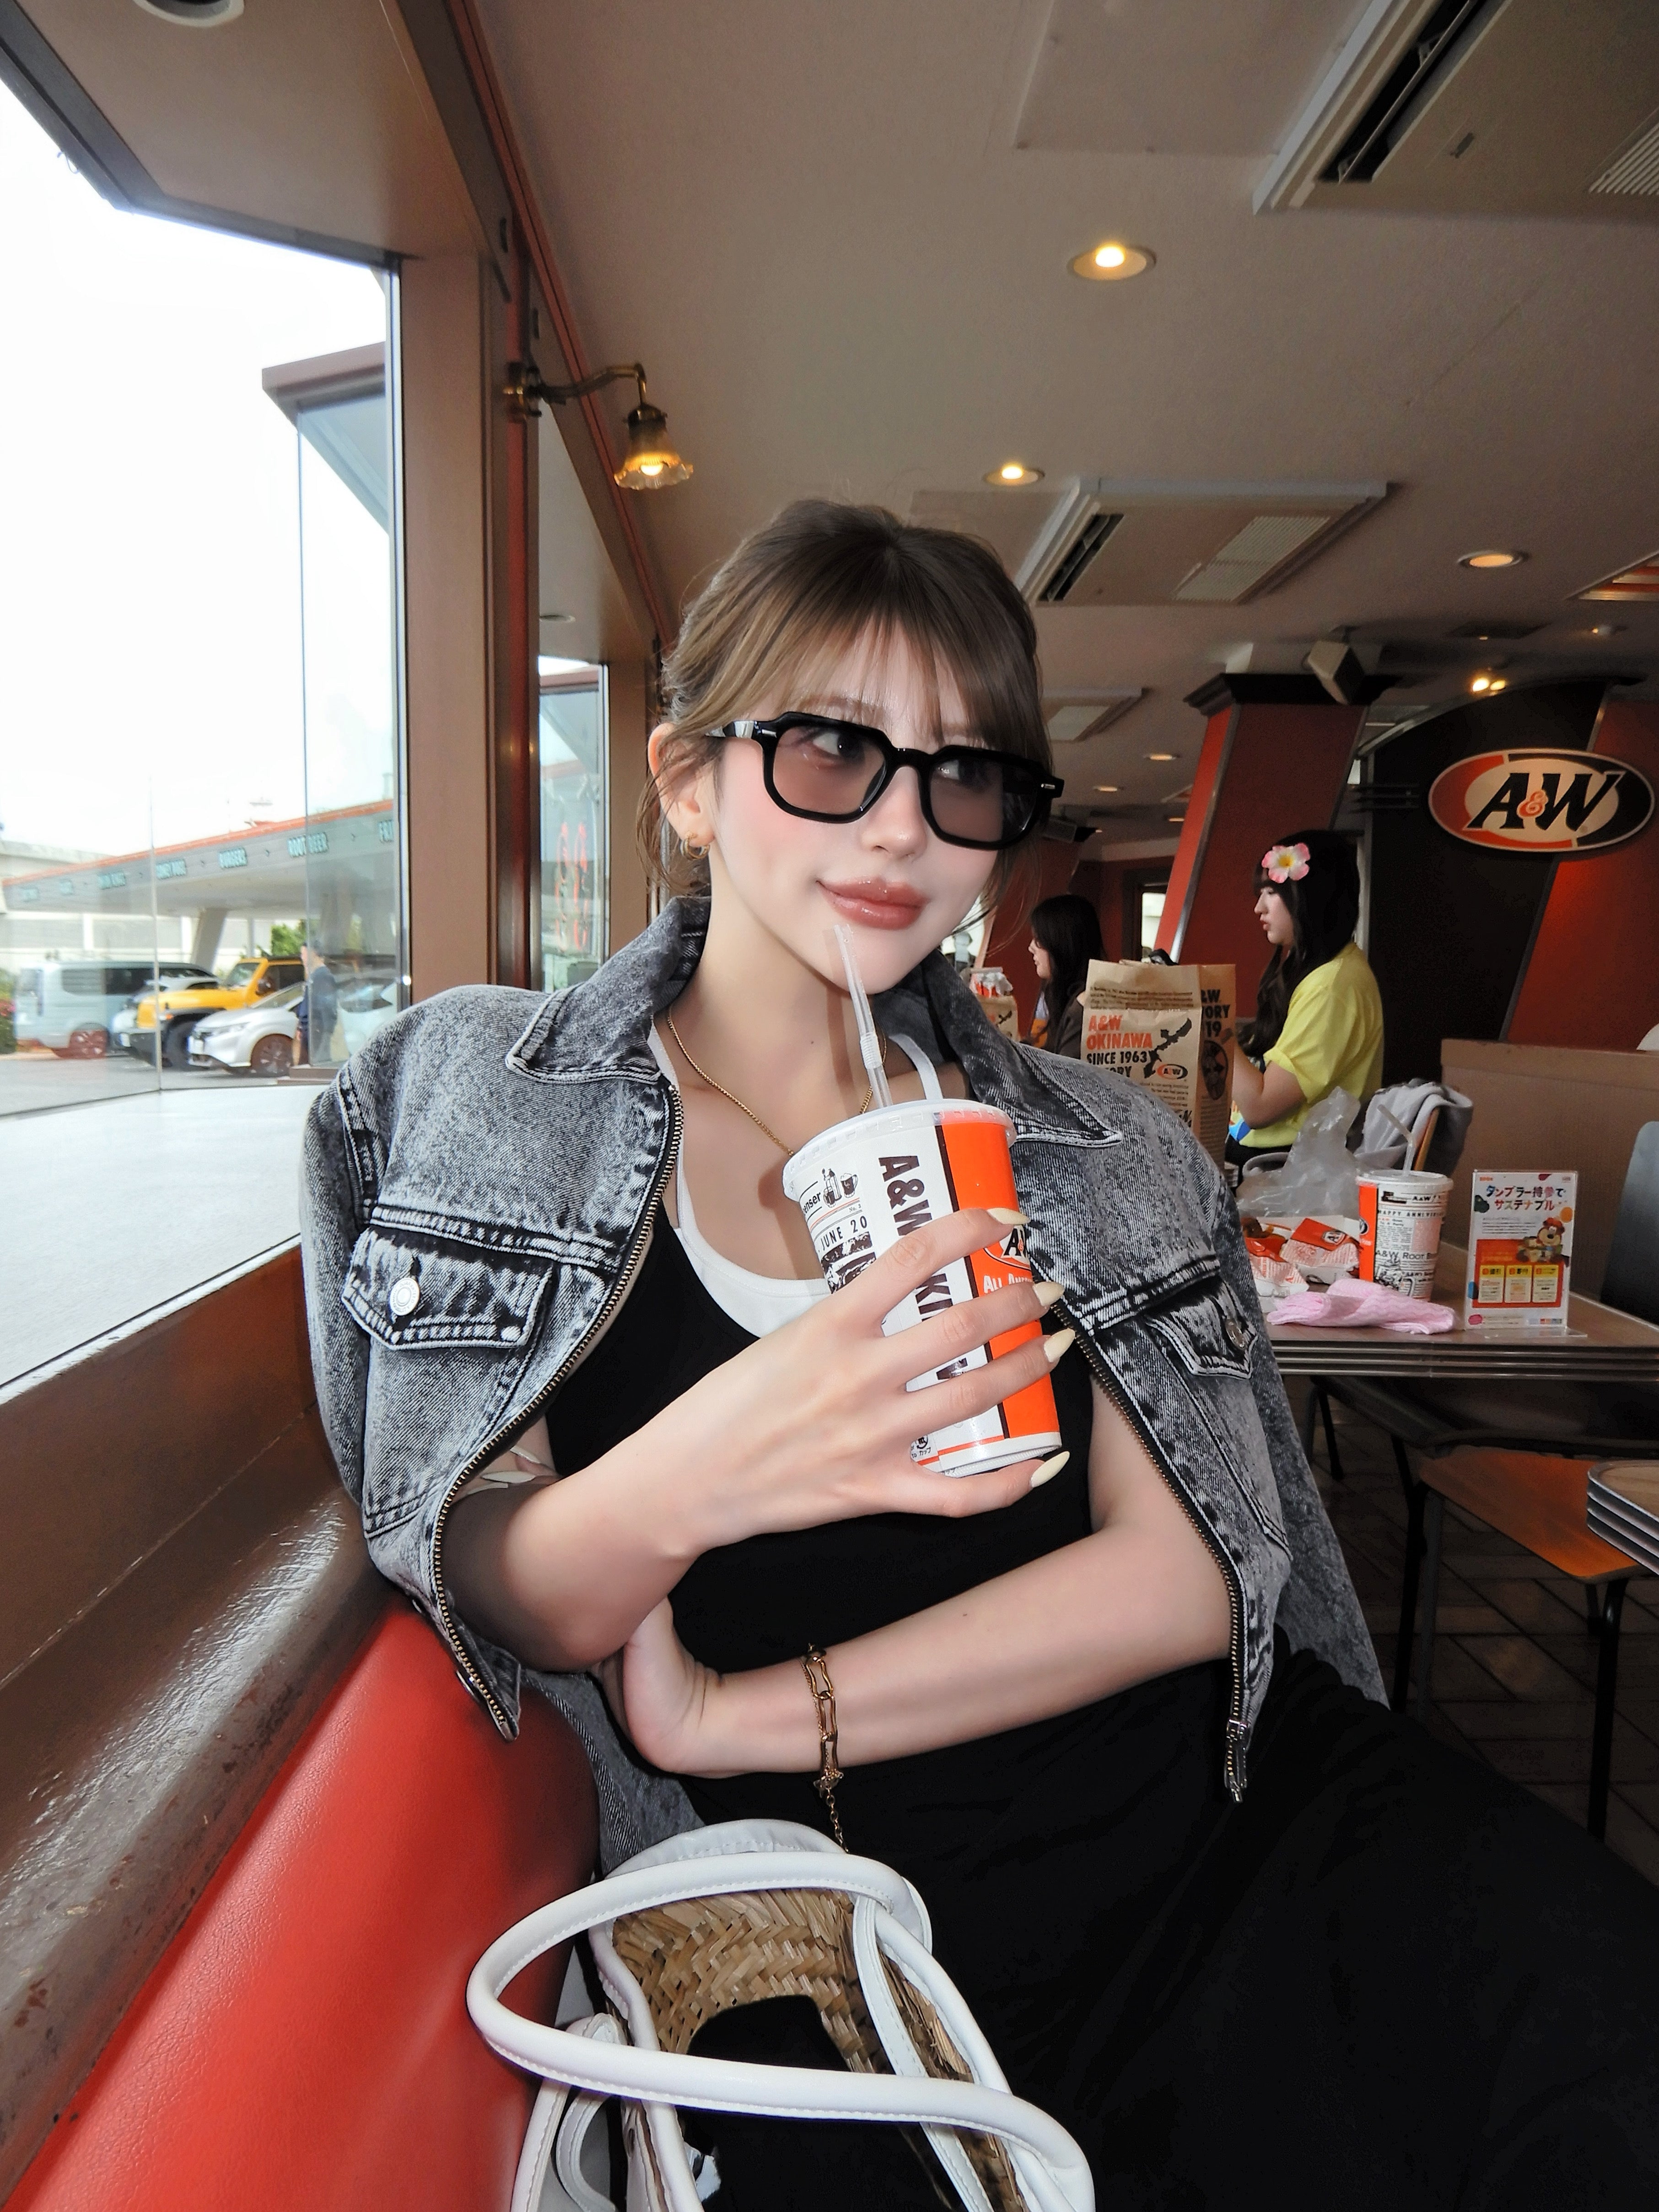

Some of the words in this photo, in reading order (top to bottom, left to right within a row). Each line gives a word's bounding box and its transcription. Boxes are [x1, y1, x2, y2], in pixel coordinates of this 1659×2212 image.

[1464, 772, 1626, 831] A&W
[1088, 1014, 1123, 1031] A&W
[1086, 1033, 1153, 1051] OKINAWA
[1087, 1052, 1116, 1065] SINCE
[1120, 1051, 1147, 1064] 1963
[803, 1192, 821, 1214] enser
[820, 1226, 843, 1252] JUNE
[850, 1215, 868, 1233] 20
